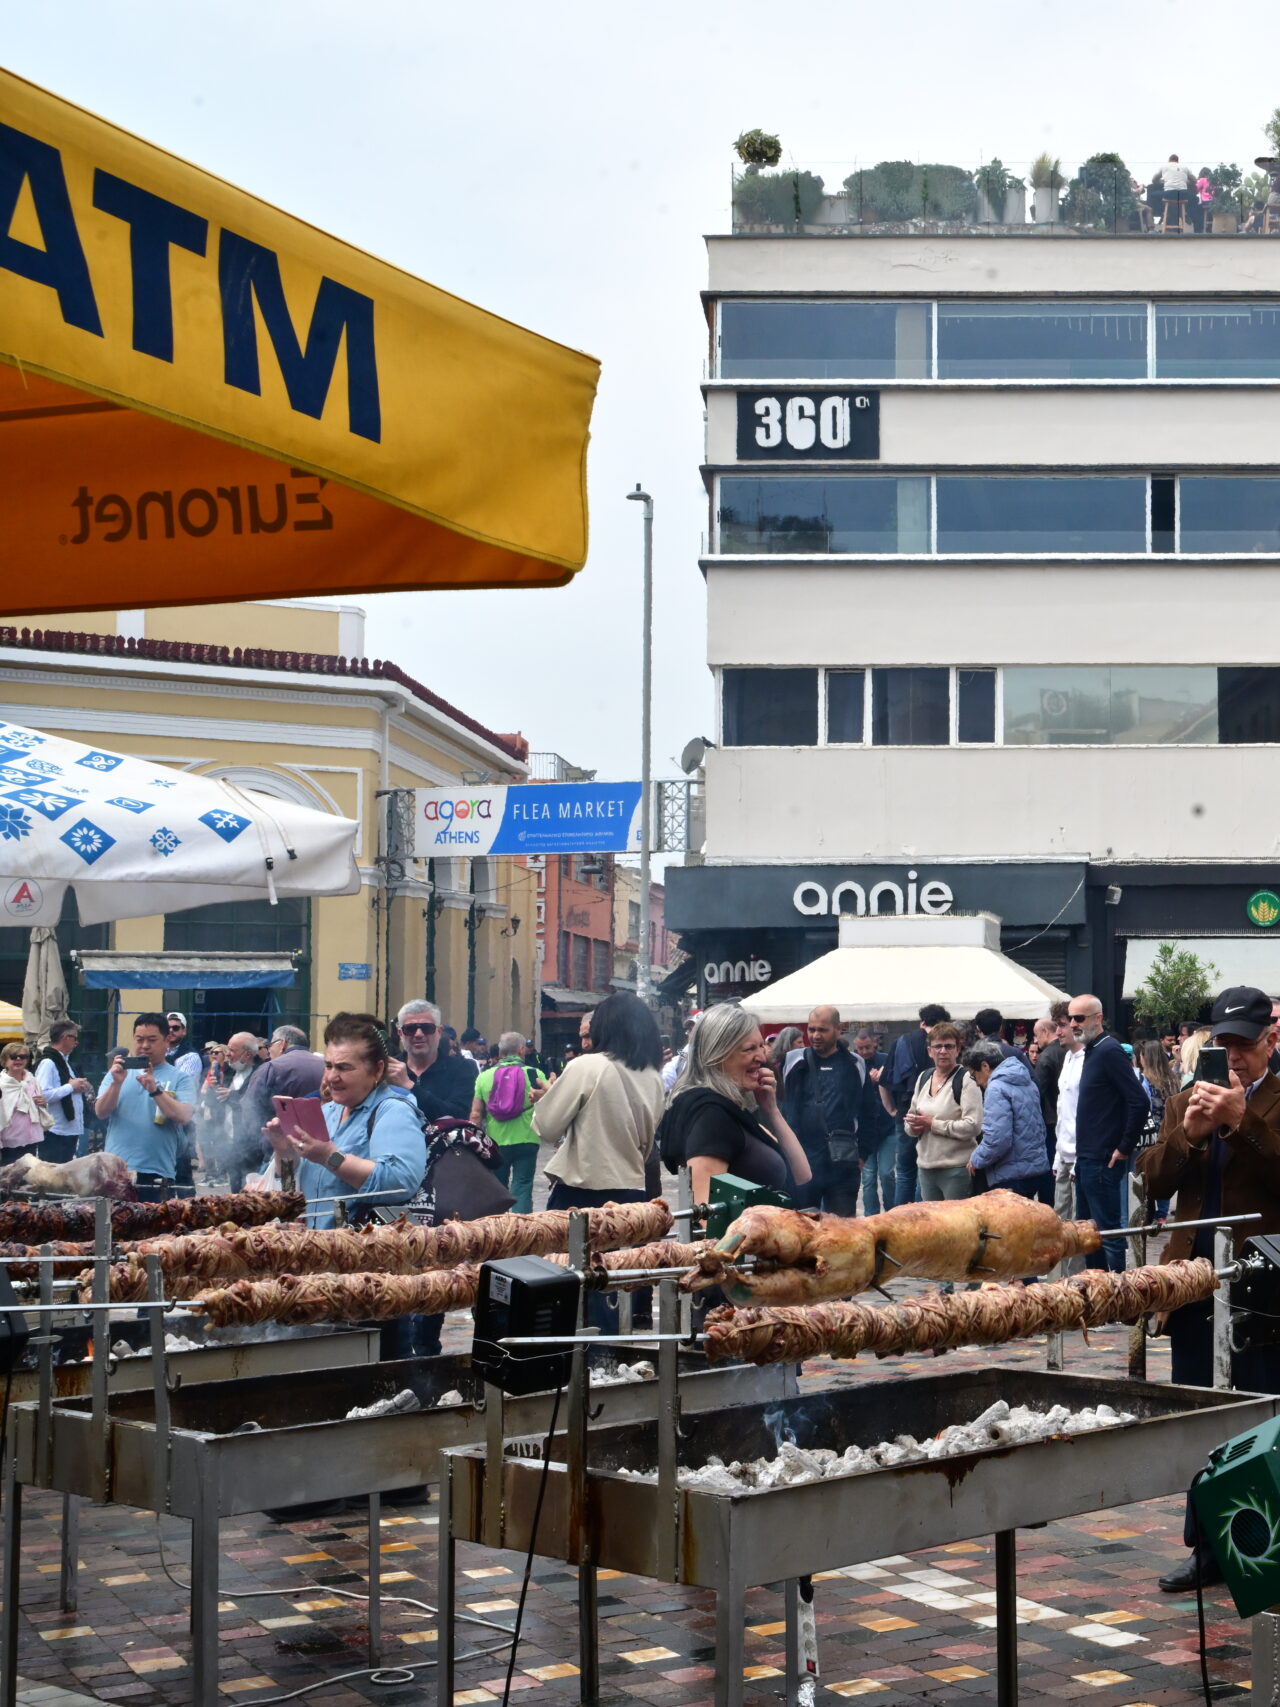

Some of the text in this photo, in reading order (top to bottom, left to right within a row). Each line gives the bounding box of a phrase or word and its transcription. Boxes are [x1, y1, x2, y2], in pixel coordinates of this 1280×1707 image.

[0, 122, 382, 444] ATM
[424, 799, 491, 833] agora
[513, 800, 625, 820] FLEA MARKET
[434, 830, 480, 844] ATHENS
[793, 870, 953, 916] annie
[704, 953, 772, 984] annie
